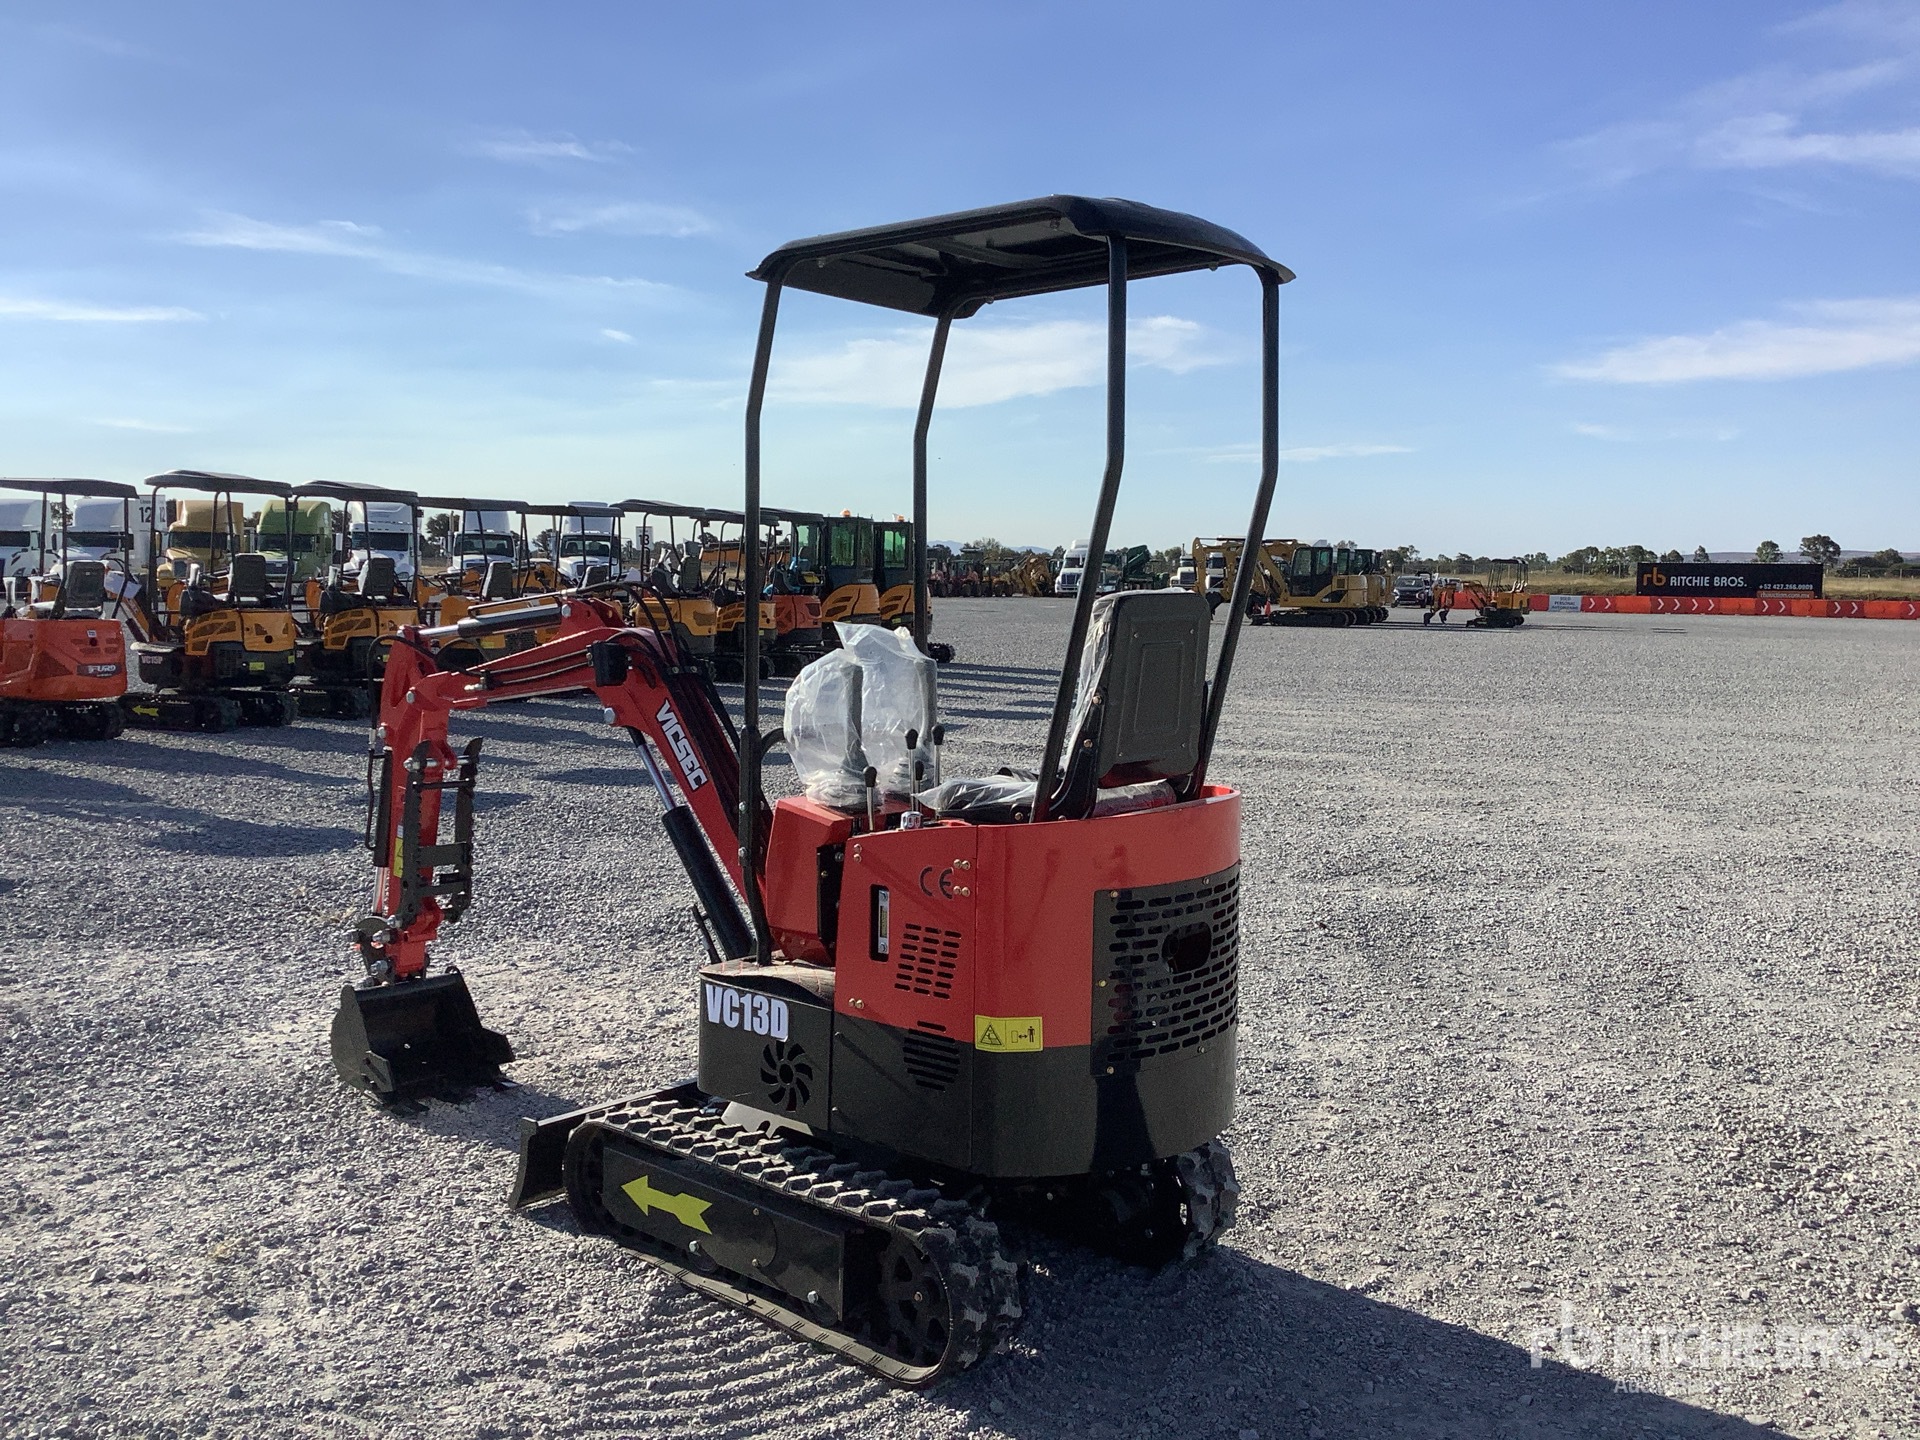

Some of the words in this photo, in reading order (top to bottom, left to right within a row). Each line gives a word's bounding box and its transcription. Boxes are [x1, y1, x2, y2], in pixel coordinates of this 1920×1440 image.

[139, 507, 152, 523] 12
[1670, 576, 1710, 587] RITCHIE
[1713, 576, 1748, 587] BROS.
[656, 698, 708, 791] VICSEC
[919, 866, 954, 900] CE
[705, 983, 789, 1042] VC13D
